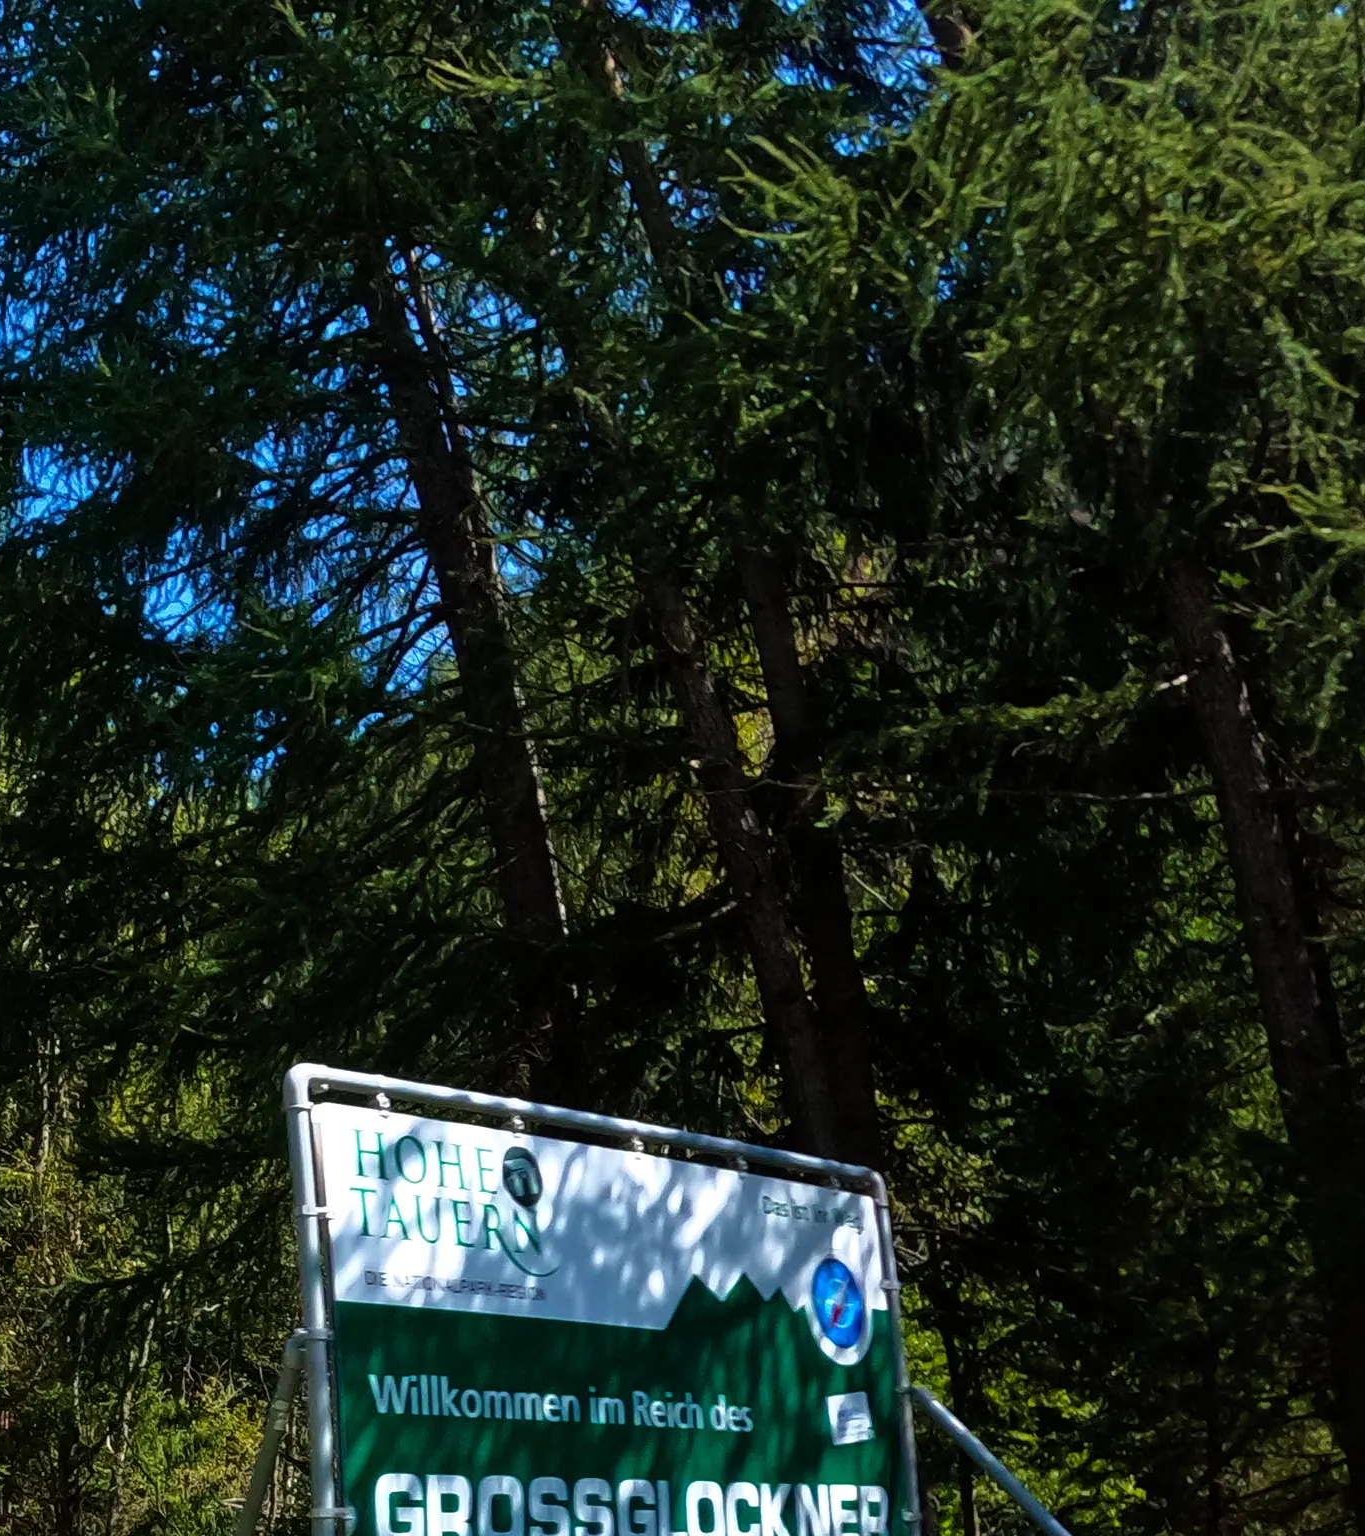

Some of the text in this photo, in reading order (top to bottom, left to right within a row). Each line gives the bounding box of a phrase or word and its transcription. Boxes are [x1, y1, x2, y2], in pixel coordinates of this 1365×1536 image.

[353, 1128, 498, 1195] HOHE
[350, 1187, 559, 1277] TAUERN
[368, 1374, 755, 1434] Willkommen im Reich des
